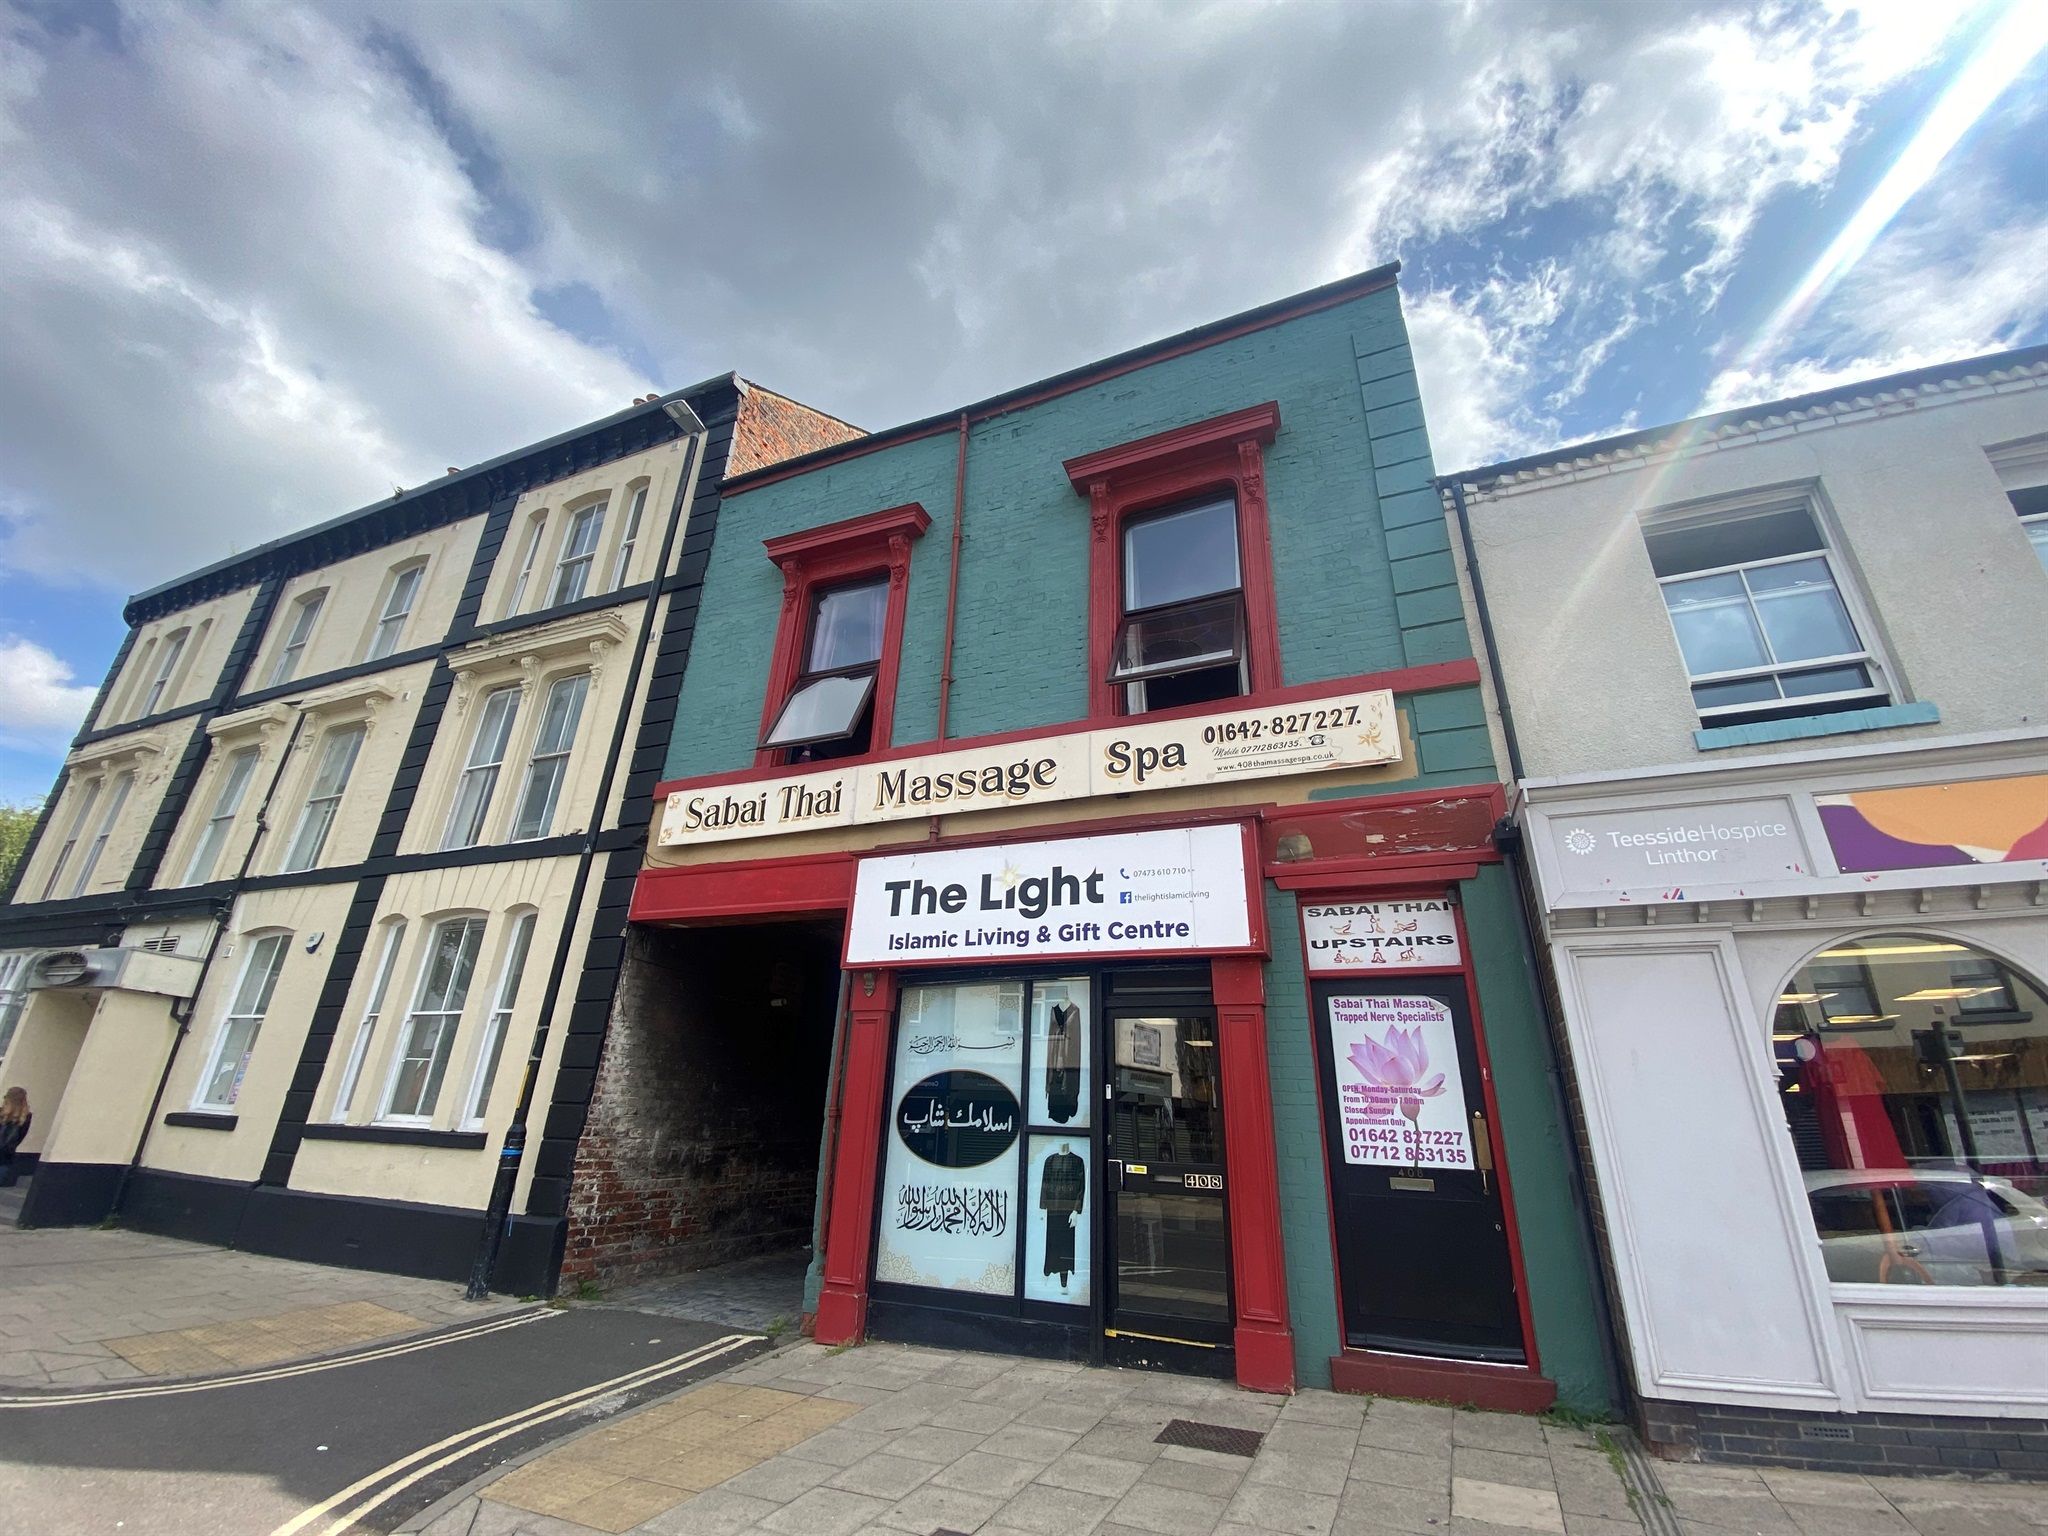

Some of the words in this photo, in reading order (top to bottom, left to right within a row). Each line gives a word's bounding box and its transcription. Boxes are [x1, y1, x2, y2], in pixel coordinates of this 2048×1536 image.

[685, 791, 767, 829] Sabai
[781, 780, 844, 820] Thai
[878, 756, 1057, 806] Massage
[1107, 739, 1188, 782] Spa
[1133, 870, 1156, 878] 07473
[884, 878, 968, 917] The
[979, 866, 1105, 919] Light
[1134, 890, 1210, 902] thelightislamicliving
[1307, 904, 1380, 918] SABAI
[1388, 901, 1449, 913] THAI
[888, 929, 959, 950] Islamic
[964, 926, 1030, 947] Living
[1036, 925, 1051, 943] &
[1058, 922, 1101, 942] Gift
[1107, 919, 1190, 940] Centre
[1310, 934, 1455, 950] UPSTAIRS
[1333, 998, 1363, 1009] Sabai
[1366, 998, 1390, 1009] Thai
[1393, 998, 1436, 1011] Massag
[1335, 1012, 1368, 1024] Trapped
[1371, 1012, 1395, 1022] Nerve
[1397, 1012, 1445, 1024] Specialists
[1344, 1106, 1367, 1114] Closed
[1369, 1107, 1395, 1116] Sunday
[1345, 1117, 1390, 1126] Appointment
[1390, 1119, 1406, 1127] Only
[1349, 1128, 1399, 1143] 01642
[1403, 1130, 1463, 1146] 827227
[1350, 1144, 1400, 1161] 07712
[1404, 1147, 1467, 1164] 863135
[1186, 1175, 1221, 1188] 408
